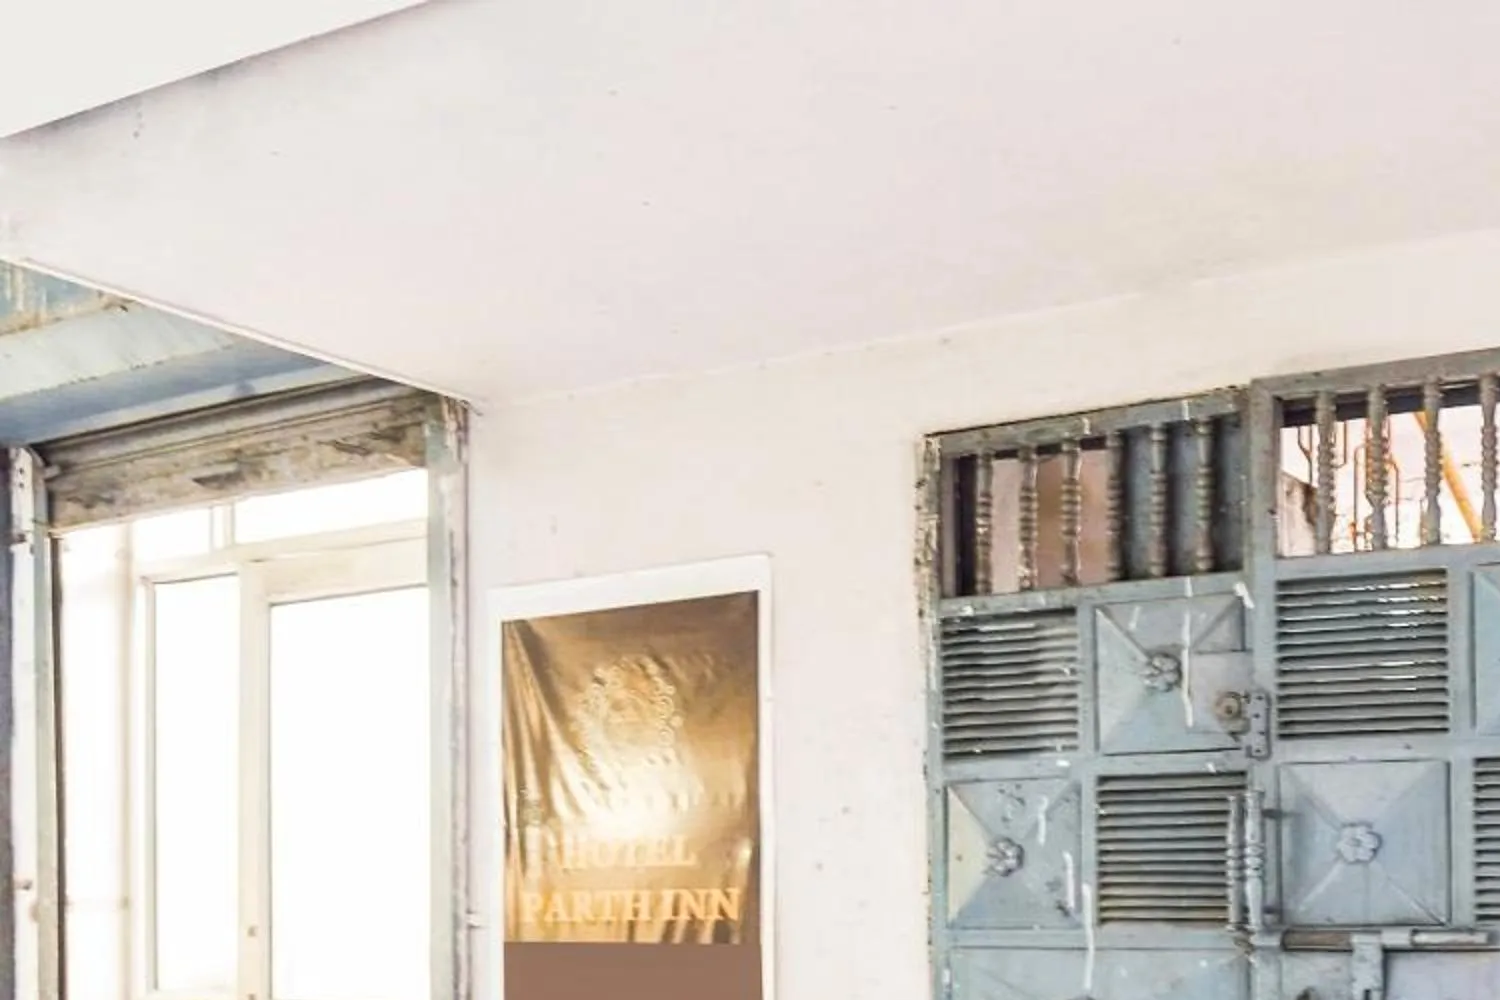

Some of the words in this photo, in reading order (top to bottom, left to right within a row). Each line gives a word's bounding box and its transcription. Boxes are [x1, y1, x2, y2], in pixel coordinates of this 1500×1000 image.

[563, 833, 698, 869] HOTEL
[521, 888, 652, 922] PARTH
[660, 886, 740, 921] INN
